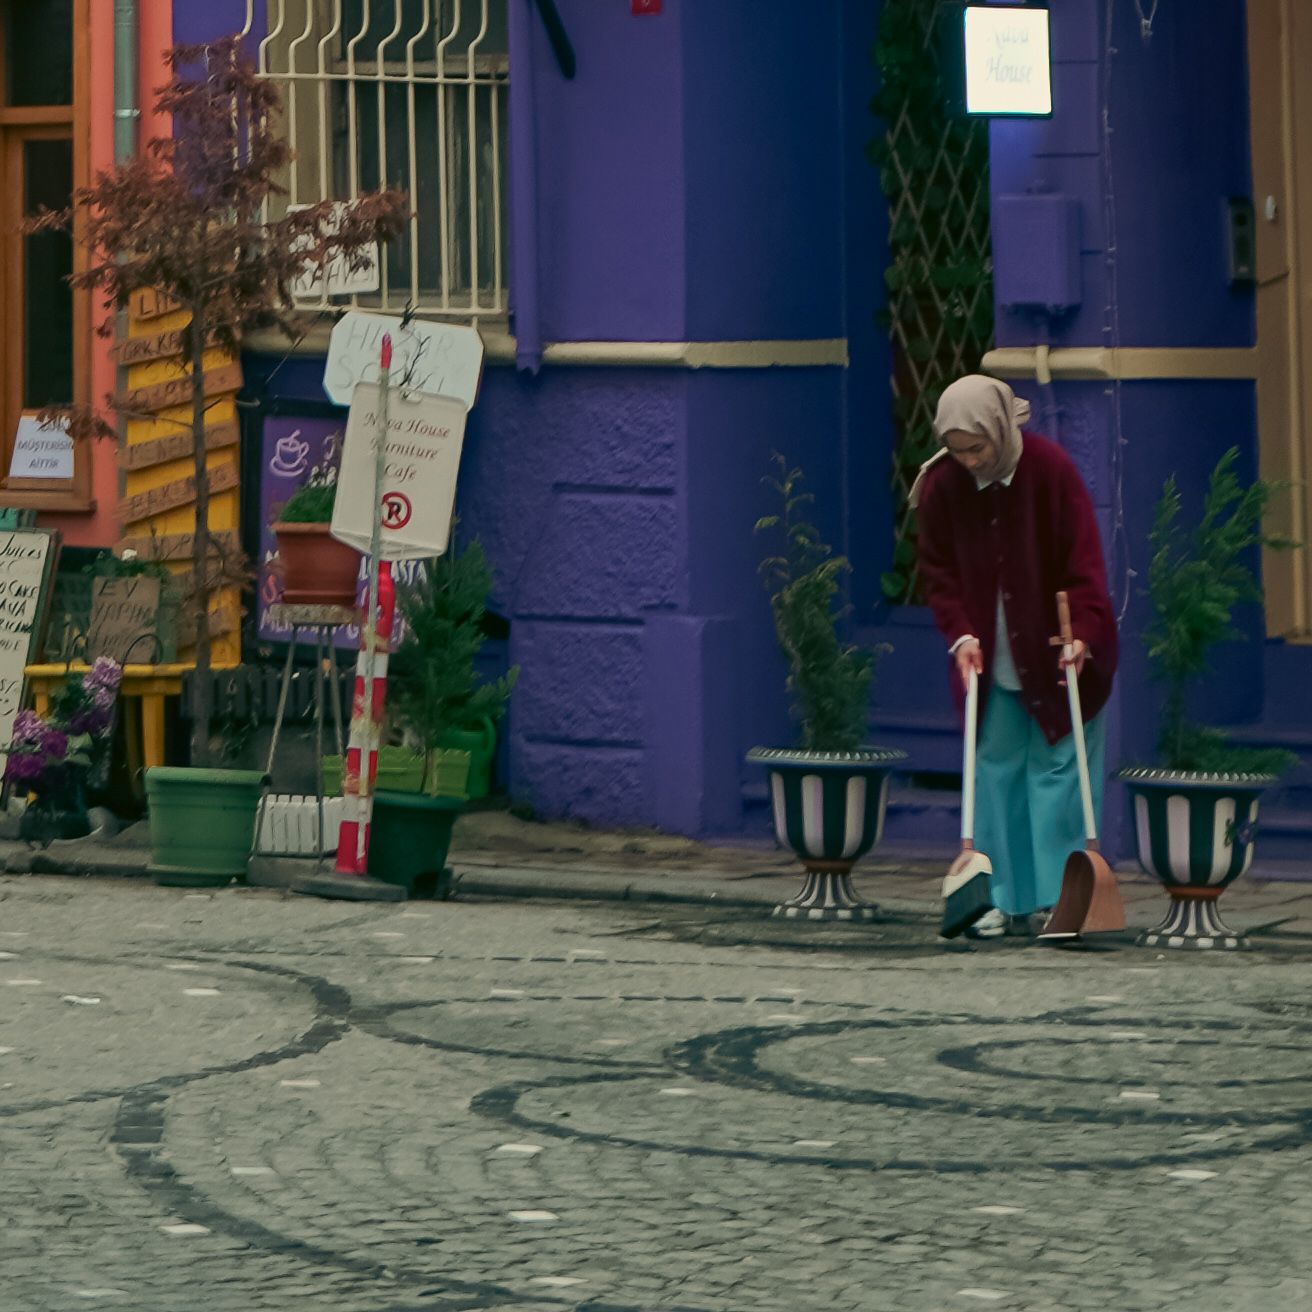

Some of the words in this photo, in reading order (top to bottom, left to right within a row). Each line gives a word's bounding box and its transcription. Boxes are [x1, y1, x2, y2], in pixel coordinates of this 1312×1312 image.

[986, 53, 1033, 84] House
[407, 419, 450, 438] House
[384, 463, 417, 484] Cafe
